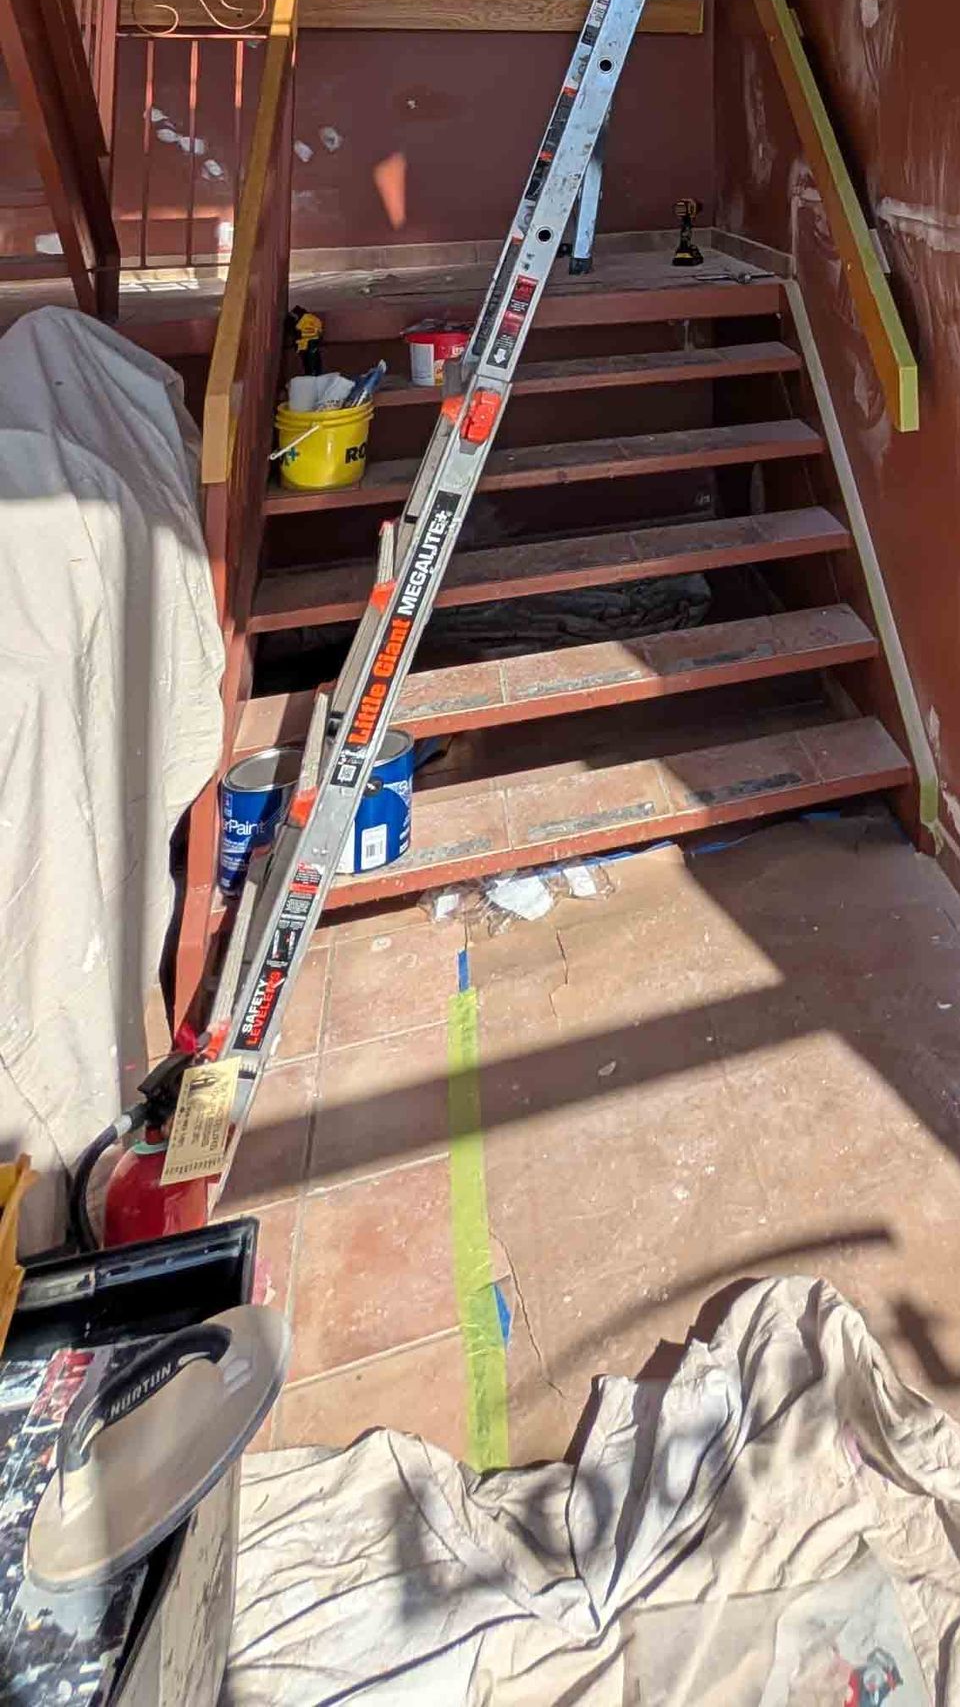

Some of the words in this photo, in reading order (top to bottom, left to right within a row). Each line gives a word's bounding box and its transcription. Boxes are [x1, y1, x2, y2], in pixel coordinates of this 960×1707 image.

[348, 683, 387, 745] Little
[373, 617, 411, 678] Giant
[397, 509, 449, 615] MEGALITE+
[241, 979, 268, 1034] SAFETY
[245, 970, 283, 1045] LEVELERS
